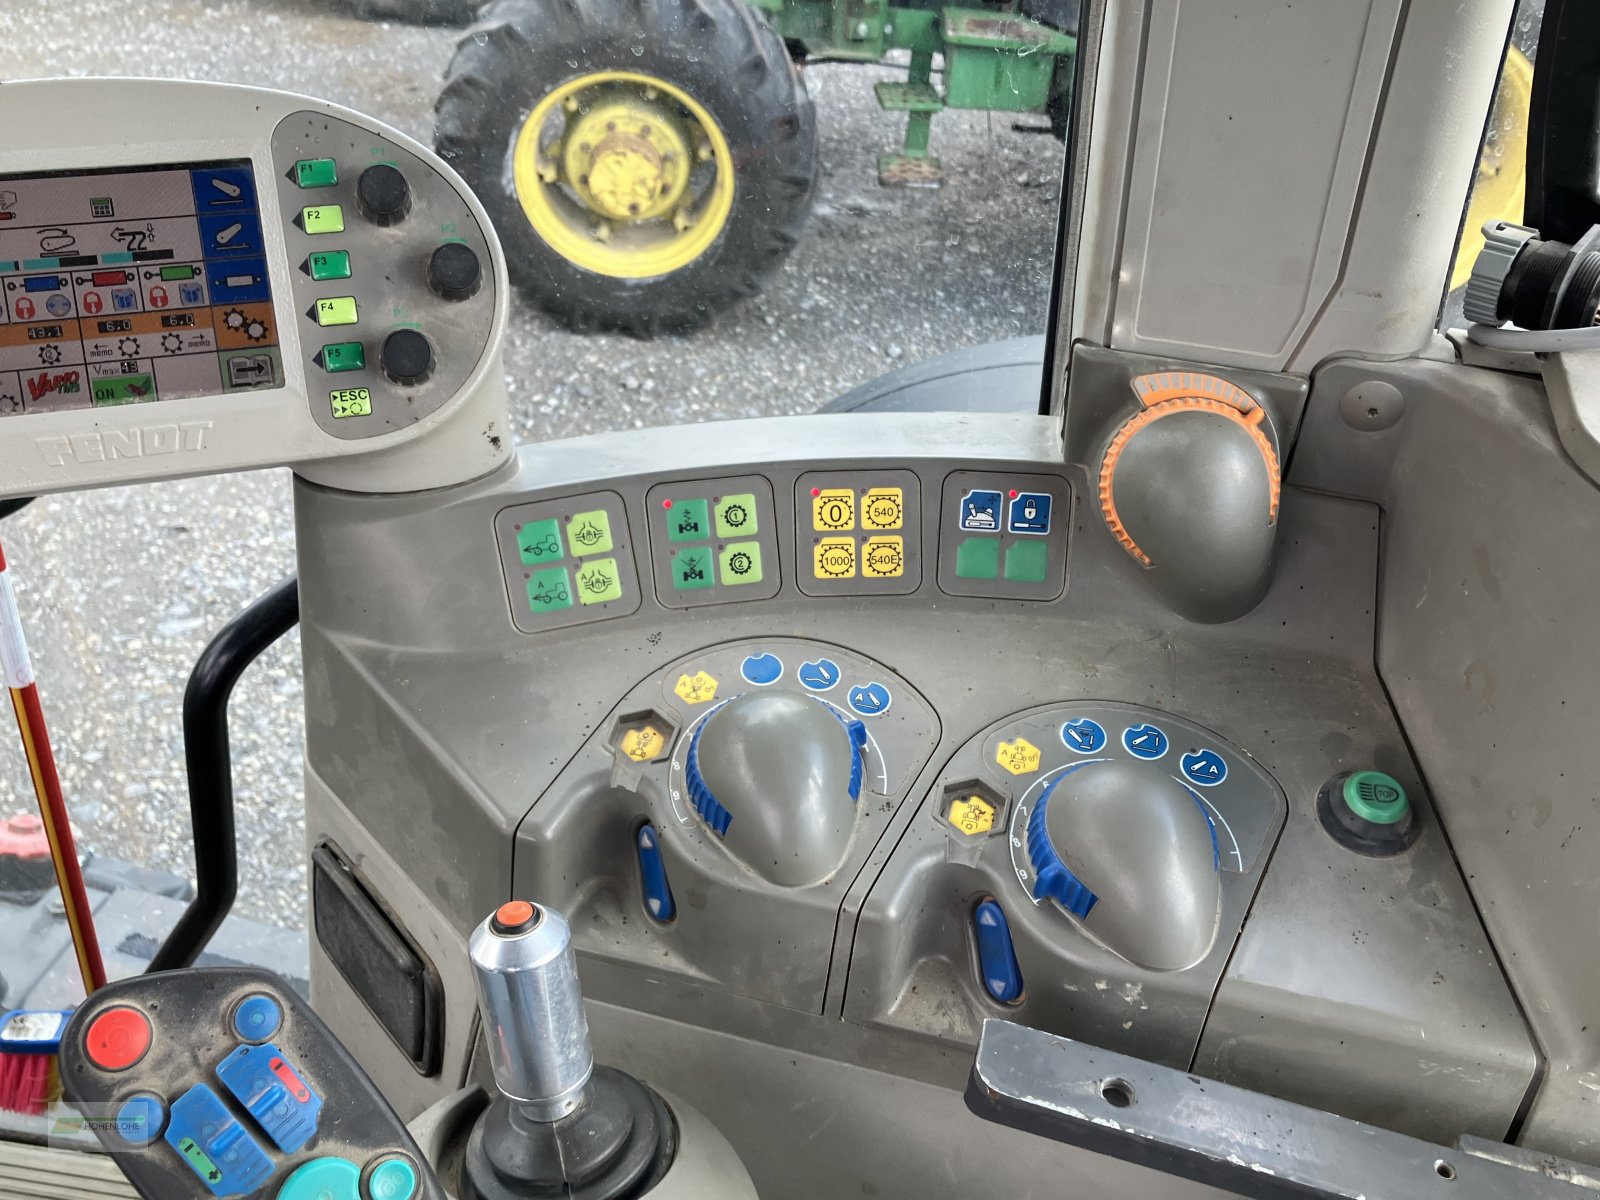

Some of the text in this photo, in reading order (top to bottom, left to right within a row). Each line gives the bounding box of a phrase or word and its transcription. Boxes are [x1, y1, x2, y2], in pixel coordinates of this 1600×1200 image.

[301, 164, 313, 173] F1
[307, 210, 320, 219] F2
[441, 223, 457, 233] P2
[314, 257, 327, 265] F3
[321, 302, 334, 311] F4
[327, 349, 341, 358] F5
[95, 388, 115, 400] ON
[340, 389, 368, 402] ESC
[36, 421, 213, 466] FENDT
[829, 505, 842, 522] 0
[874, 507, 894, 517] 540
[824, 556, 850, 566] 1000
[871, 554, 898, 565] 540E
[581, 573, 588, 581] A
[537, 581, 545, 589] A
[855, 693, 864, 702] A
[1208, 765, 1218, 774] A
[1377, 790, 1394, 798] TOP
[1012, 837, 1021, 848] 8
